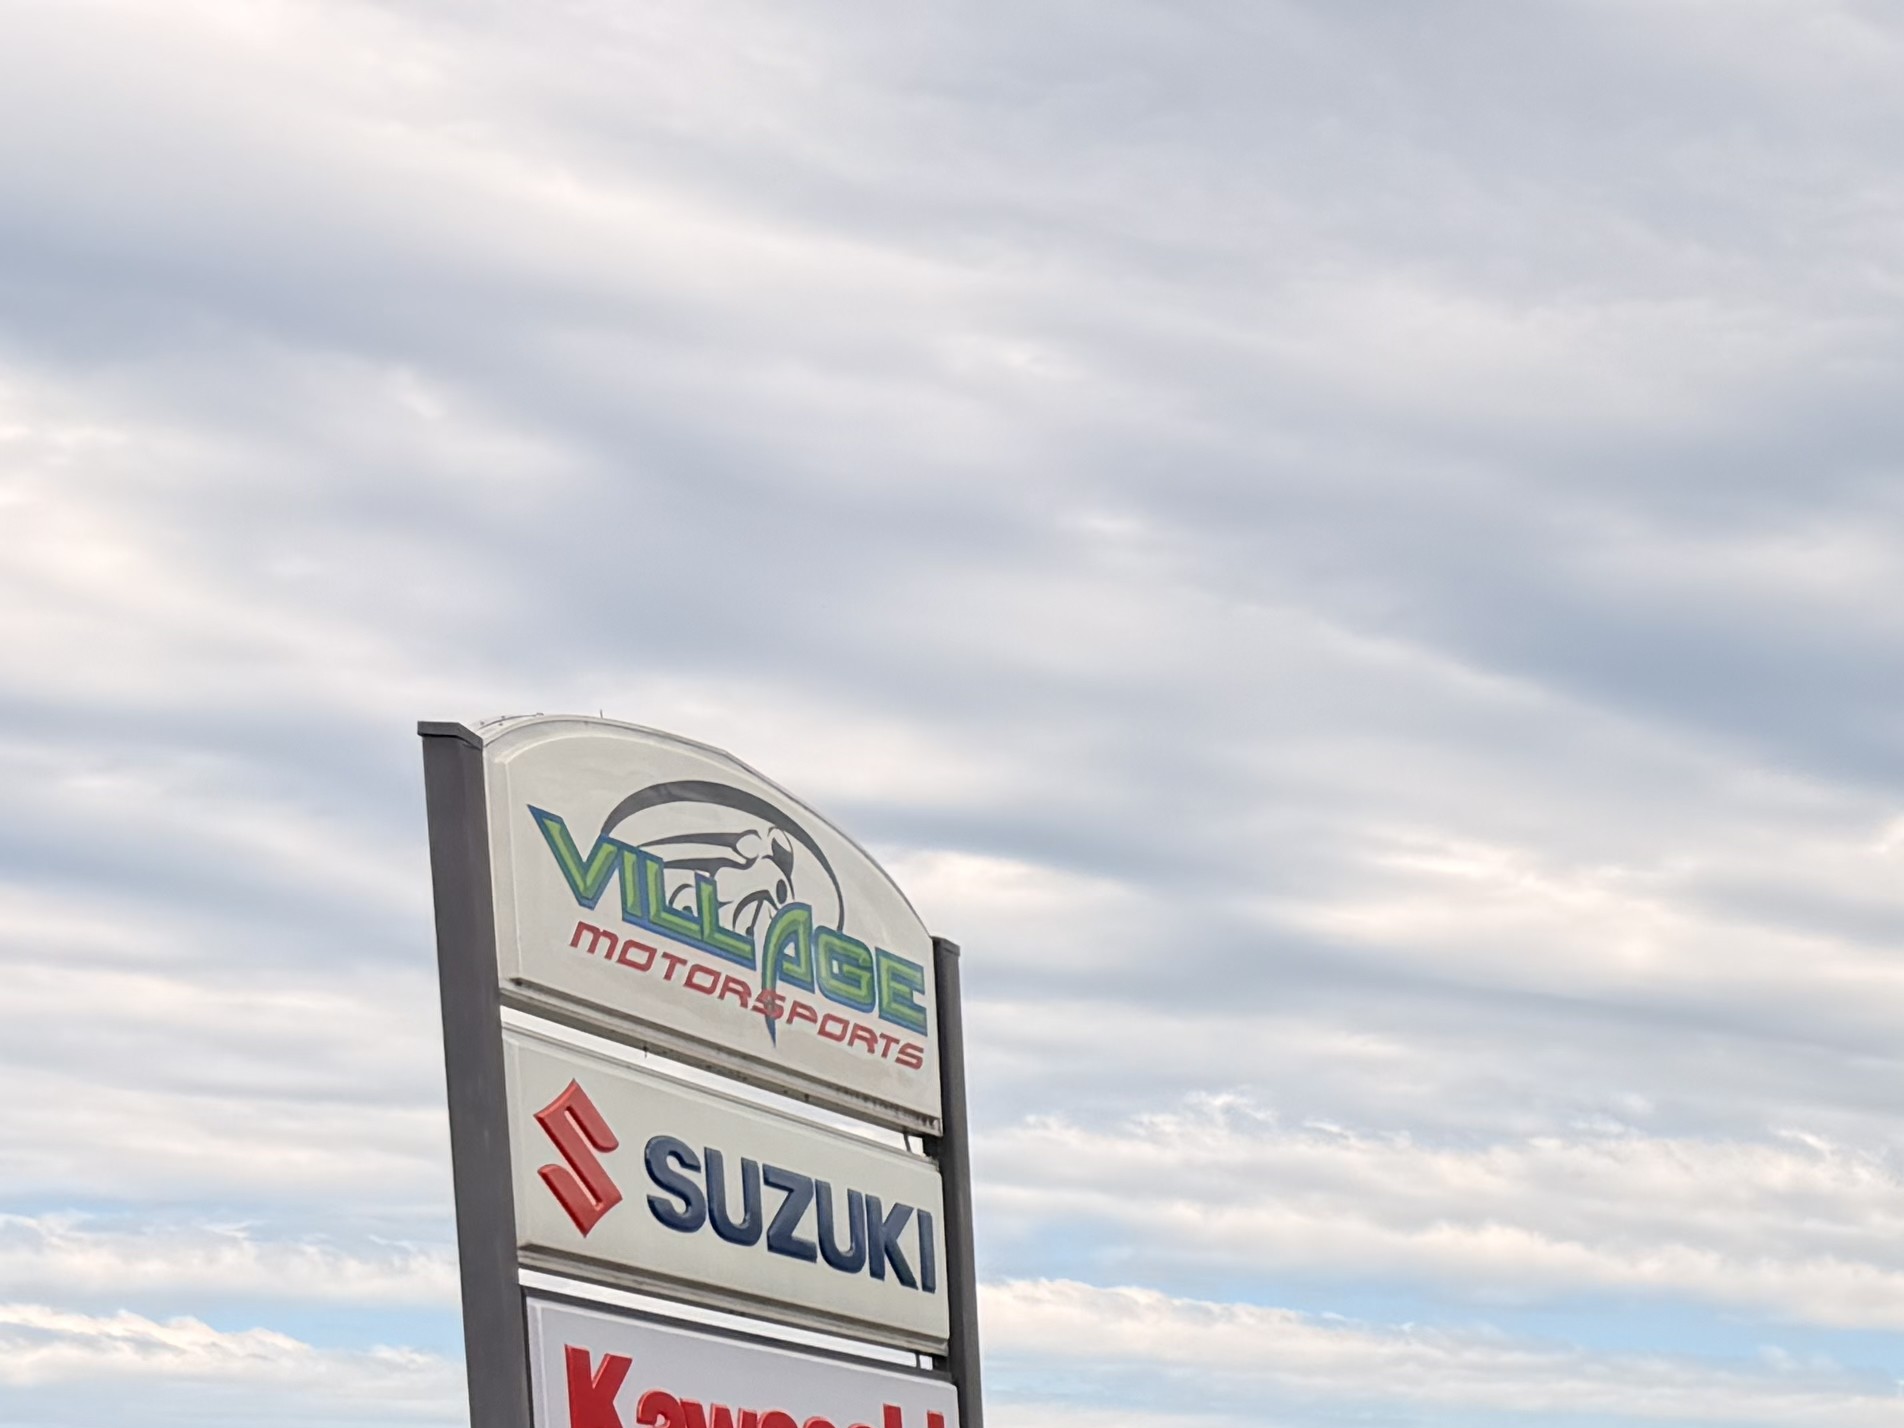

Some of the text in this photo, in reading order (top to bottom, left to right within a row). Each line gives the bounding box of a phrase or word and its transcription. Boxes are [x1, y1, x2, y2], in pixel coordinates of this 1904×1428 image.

[527, 804, 928, 1047] VILLAGE
[569, 921, 924, 1070] MOTORSPORTS
[644, 1135, 936, 1294] SUZUKI
